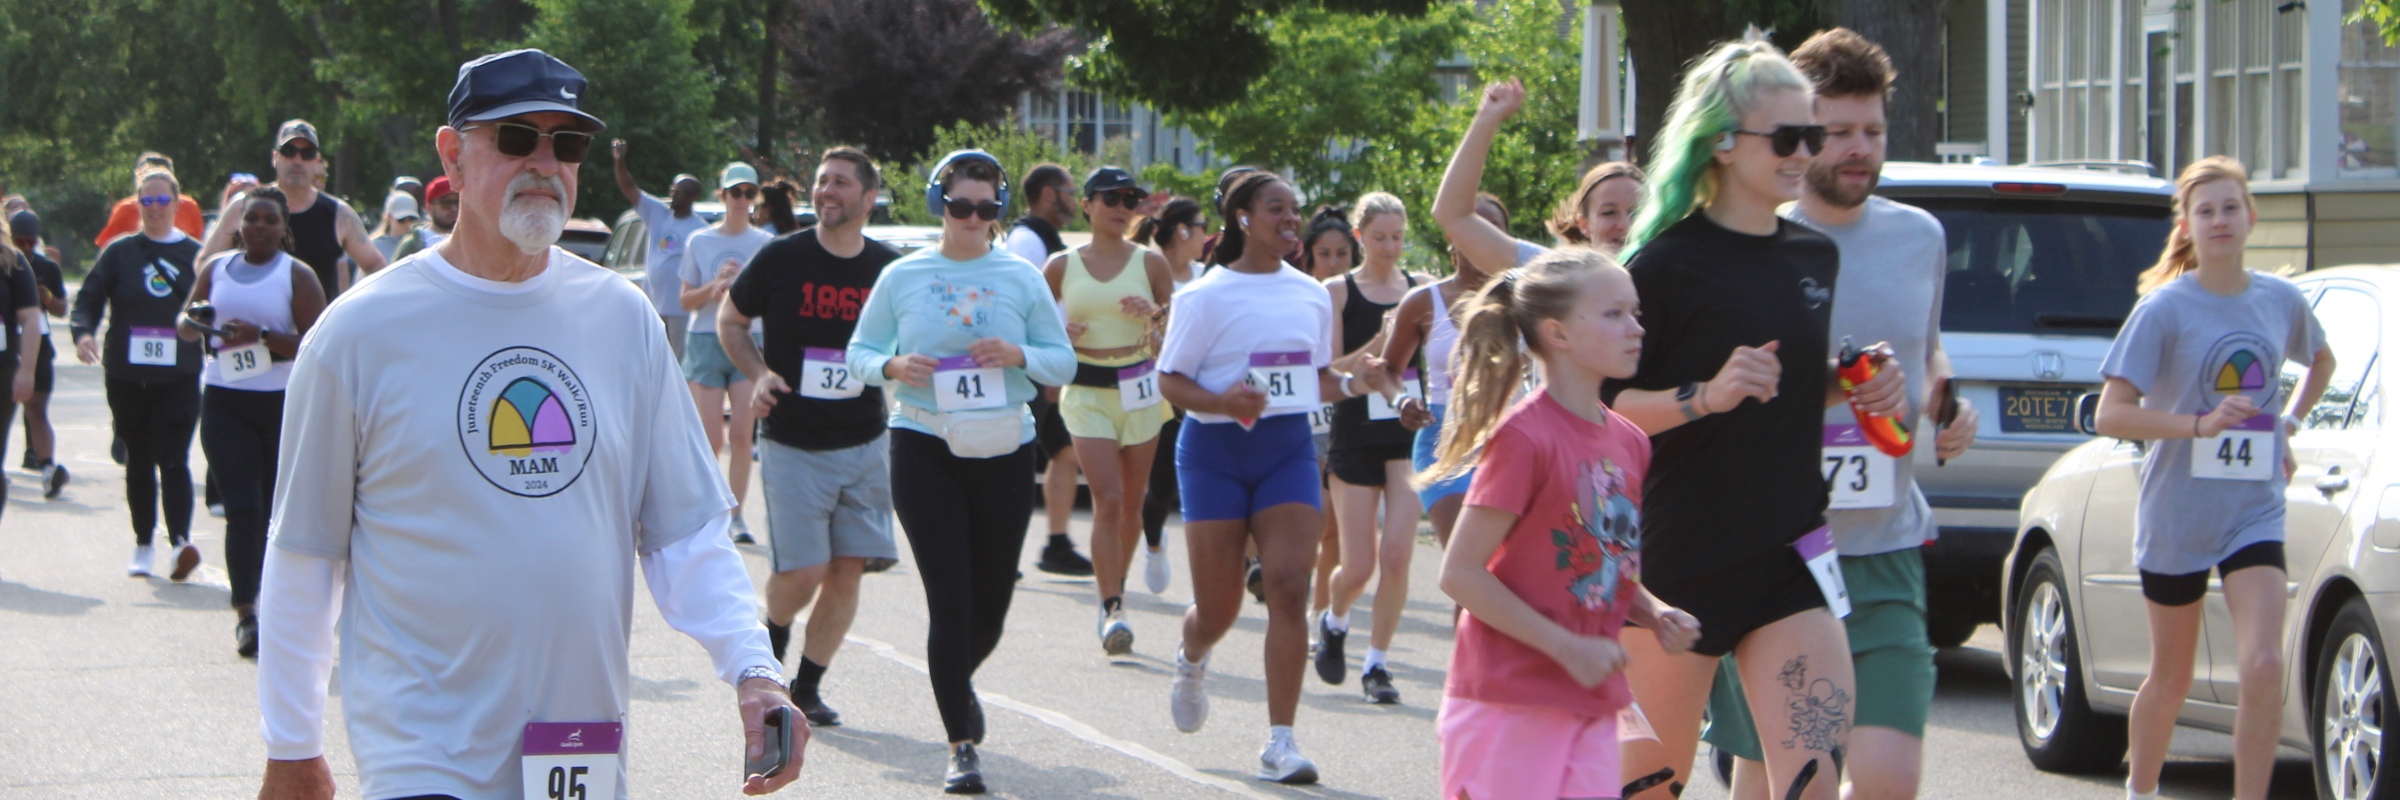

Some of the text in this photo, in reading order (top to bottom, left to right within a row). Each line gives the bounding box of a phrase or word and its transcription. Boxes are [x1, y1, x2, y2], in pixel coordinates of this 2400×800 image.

[144, 341, 164, 358] 98
[232, 349, 257, 372] 39
[821, 367, 848, 391] 32
[956, 373, 985, 399] 41
[467, 371, 494, 434] Juneteenth
[490, 354, 538, 374] Freedom
[541, 359, 556, 374] 5K
[2216, 437, 2253, 467] 44
[509, 457, 560, 475] MAM
[1825, 454, 1870, 492] 73
[524, 480, 548, 490] 2024
[548, 766, 589, 800] 95
